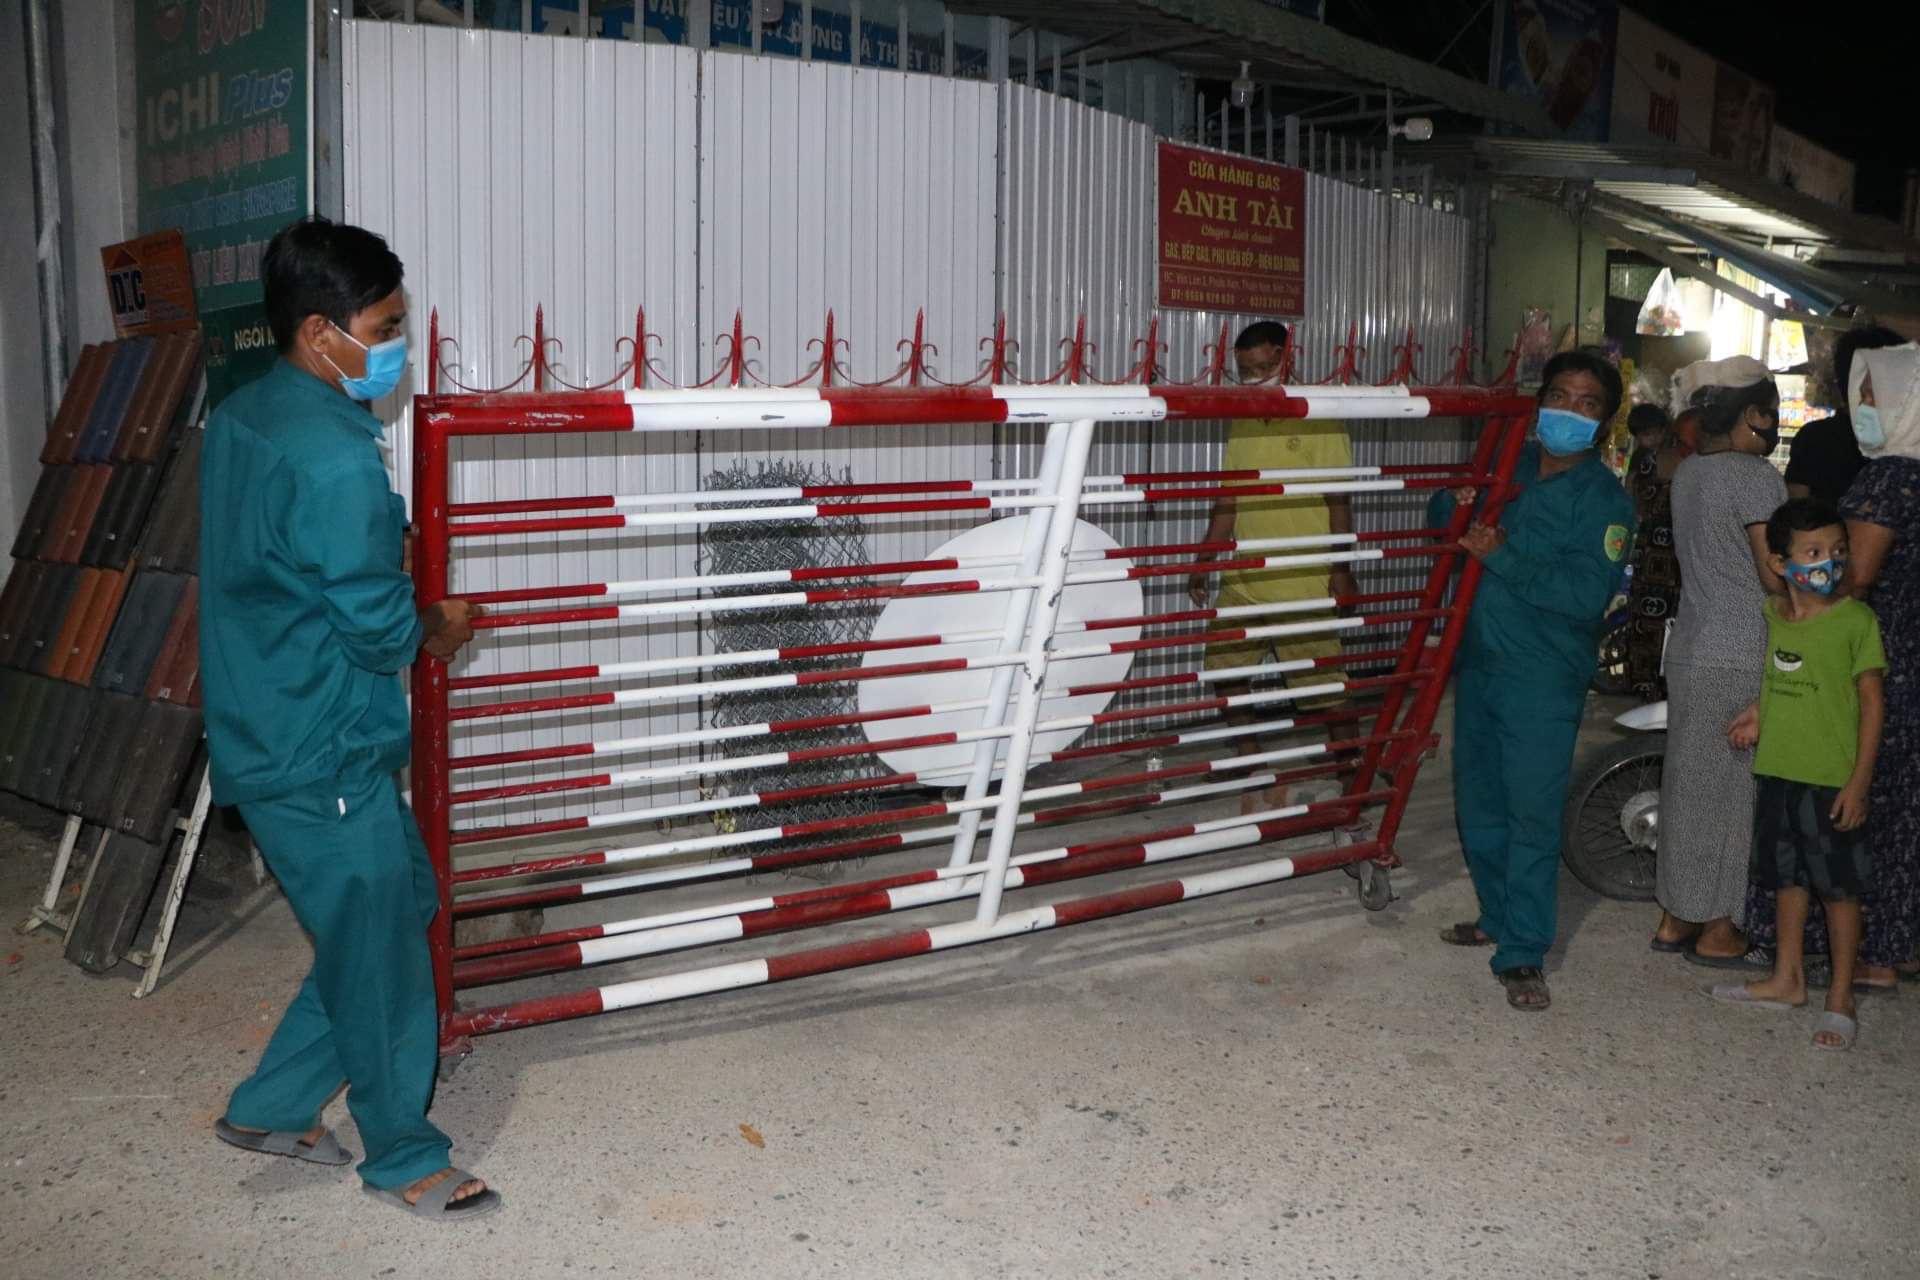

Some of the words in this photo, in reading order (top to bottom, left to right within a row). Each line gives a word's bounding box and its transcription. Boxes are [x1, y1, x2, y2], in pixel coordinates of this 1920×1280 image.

[1188, 157, 1216, 181] CỬA
[1219, 162, 1254, 188] HÀNG
[1257, 173, 1281, 192] GAS
[1172, 188, 1239, 223] ANH
[1247, 197, 1295, 230] TÀI
